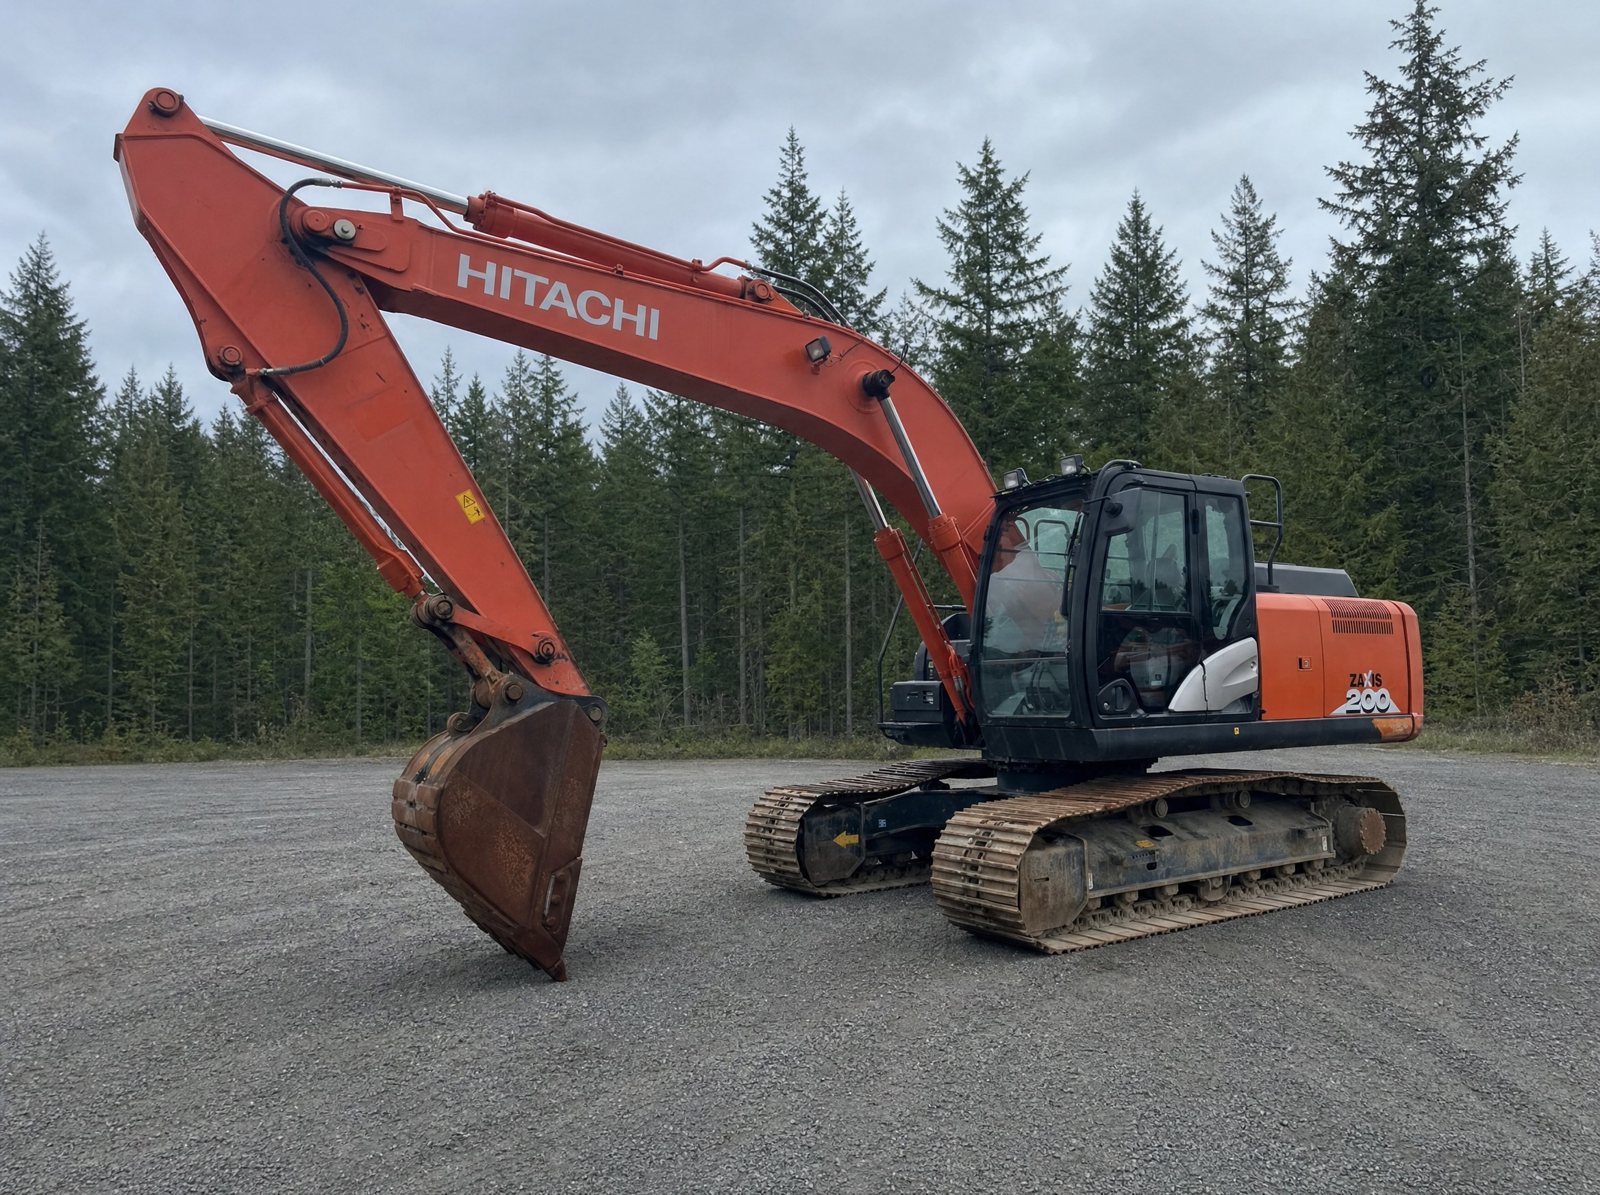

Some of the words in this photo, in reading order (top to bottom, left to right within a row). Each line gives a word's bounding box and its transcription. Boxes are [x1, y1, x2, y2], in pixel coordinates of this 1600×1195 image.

[457, 253, 660, 341] HITACHI
[1349, 670, 1382, 687] ZAXIS
[1346, 688, 1391, 713] 200
